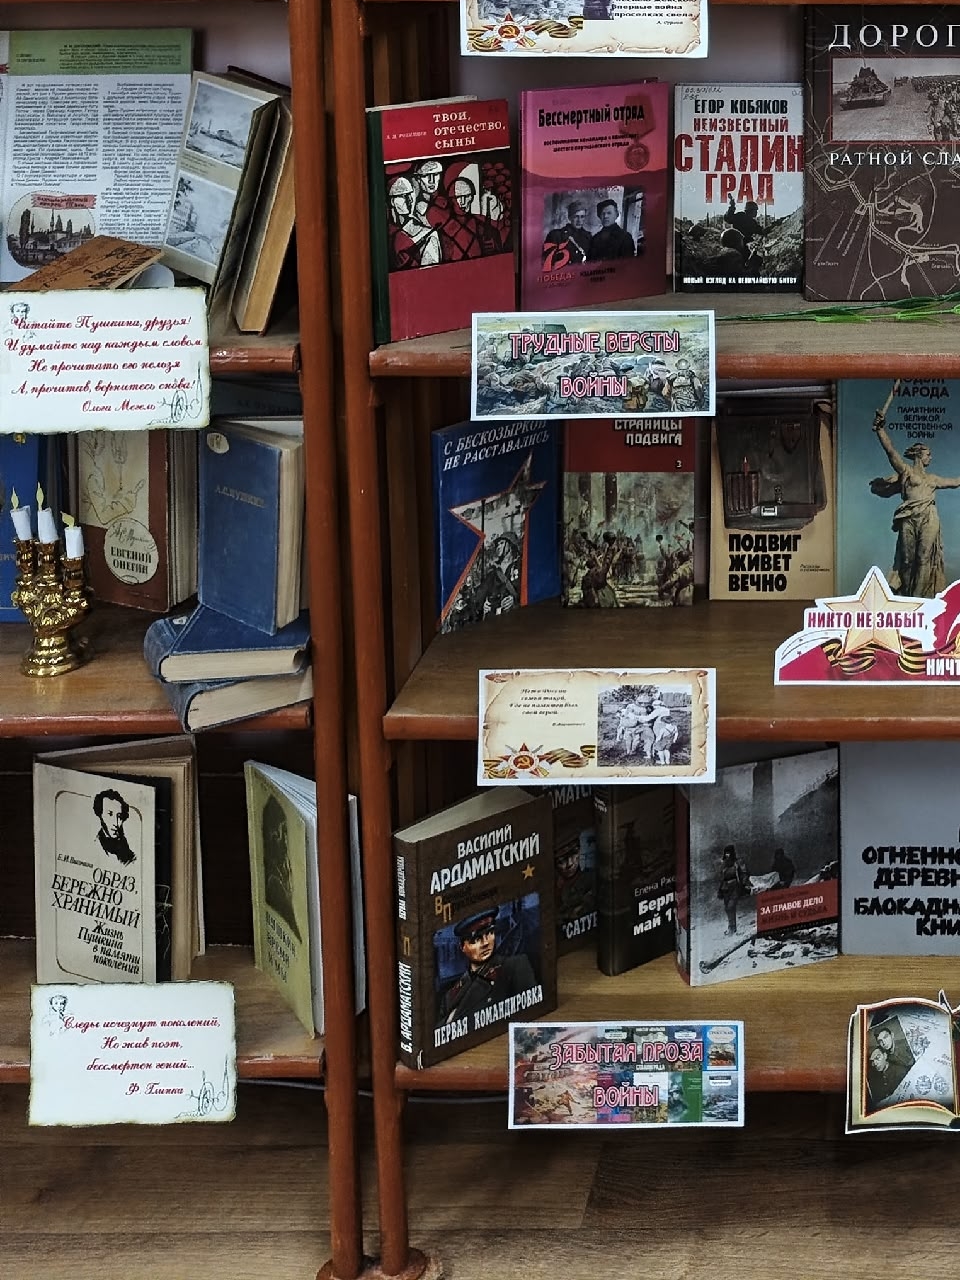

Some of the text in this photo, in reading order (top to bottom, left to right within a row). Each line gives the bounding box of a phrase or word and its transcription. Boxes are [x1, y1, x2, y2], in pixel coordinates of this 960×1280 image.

[695, 100, 787, 114] ЕГОР КОБЯКОВ
[694, 117, 788, 132] НЕИЗВЕСТНЫЙ
[830, 149, 912, 166] РАТНОЙ
[706, 174, 774, 205] ГРАД
[11, 315, 191, 332] Читайте Пушкина, друзья!
[19, 340, 77, 356] думайте
[81, 341, 101, 353] над
[105, 341, 159, 353] каждым
[162, 335, 202, 347] словом
[508, 331, 679, 359] ТРУДНЫЕ ВЕРСТЫ
[28, 360, 180, 376] Не прочитать его нельзя
[31, 380, 92, 397] прочитав,
[95, 381, 155, 396] вернитесь
[561, 372, 627, 397] ВОЙНЫ
[626, 433, 682, 445] ПОДВИГА
[443, 431, 549, 471] НЕ РАССТАВАЛИСЬ
[729, 534, 801, 552] ПОДВИГ
[729, 553, 791, 572] ЖИВЕТ
[729, 574, 787, 592] ВЕЧНО
[807, 612, 928, 630] НИКТО НЕ ЗАБЫТ,
[457, 823, 512, 859] ВАСИЛИЙ
[430, 833, 540, 895] АРДАМАТСКИЙ
[52, 875, 123, 905] БЕРЕЖНО
[93, 868, 138, 895] ОБРАЗ,
[51, 892, 140, 929] ХРАНИМЫЙ
[761, 896, 824, 915] ЗА ПРАВОЕ ДЕЛО
[634, 915, 661, 936] май
[77, 927, 123, 950] Пушкина
[93, 955, 139, 974] поколений
[100, 947, 140, 964] памяти
[63, 1016, 220, 1032] Следы исчезнут поколений,
[434, 984, 543, 1047] ПЕРВАЯ КОМАНДИРОВКА
[101, 1037, 182, 1049] Но жив поэт,
[550, 1041, 703, 1071] ЗАБЫТАЯ ПРОЗА
[125, 1083, 184, 1096] Ф. Глинка
[594, 1082, 658, 1107] ВОЙНЫ
